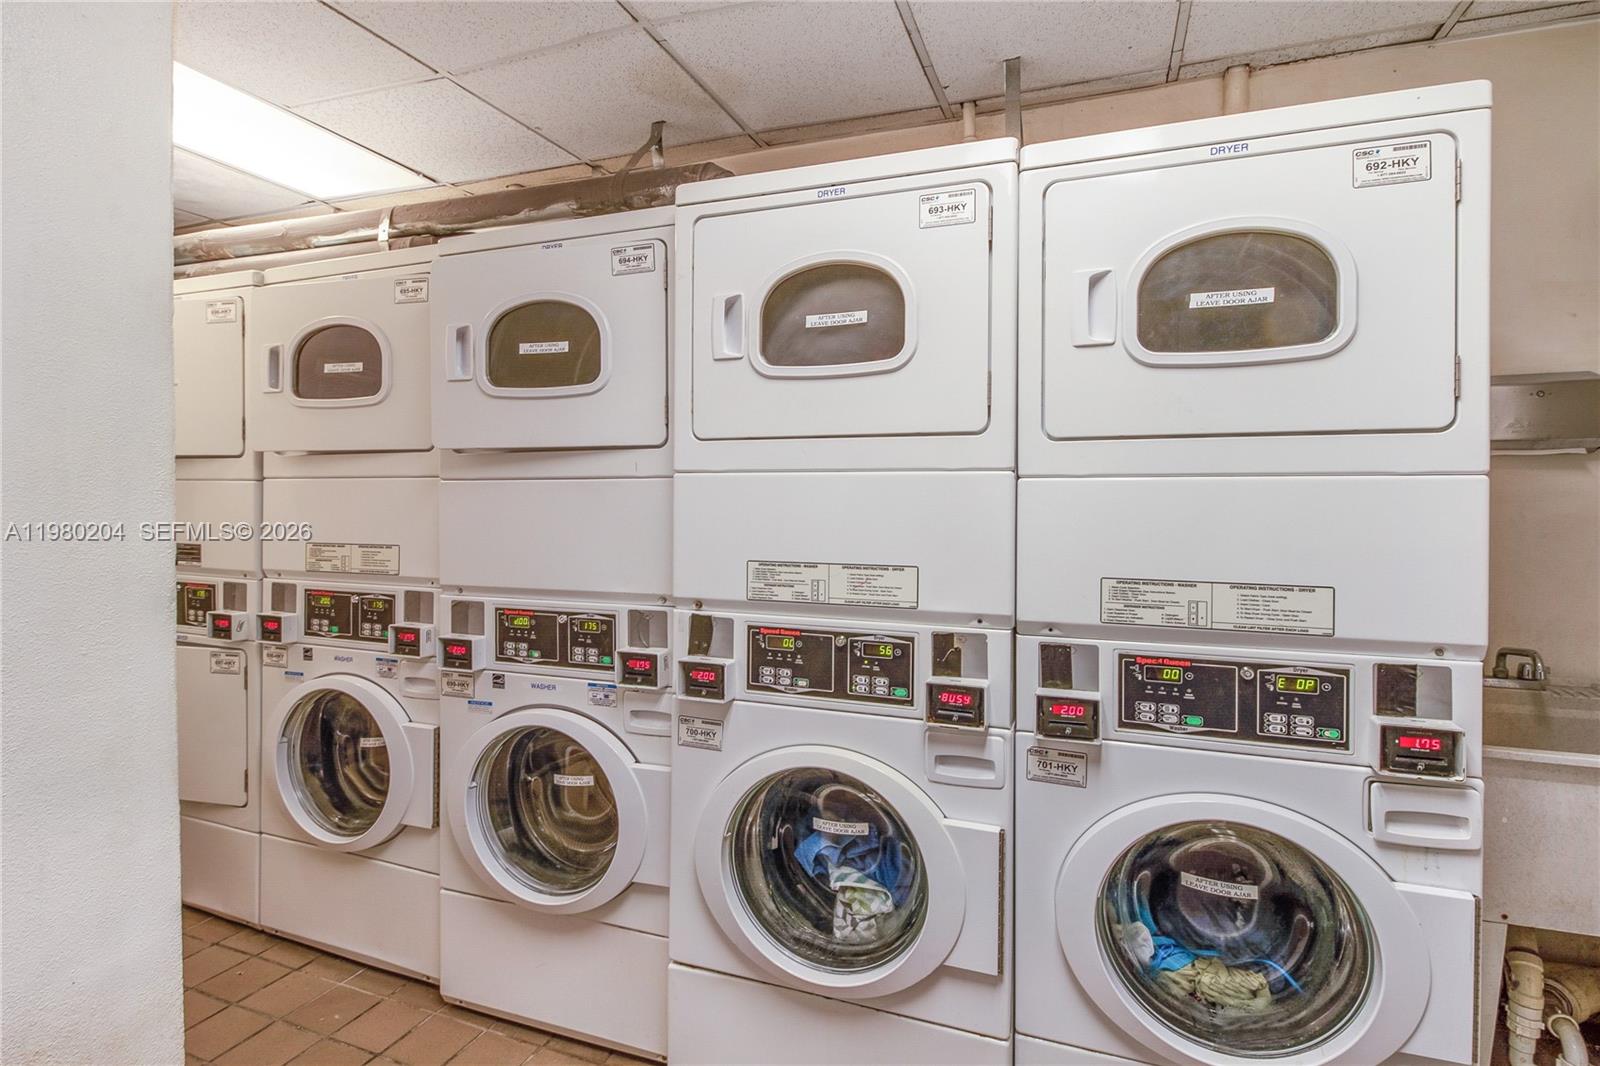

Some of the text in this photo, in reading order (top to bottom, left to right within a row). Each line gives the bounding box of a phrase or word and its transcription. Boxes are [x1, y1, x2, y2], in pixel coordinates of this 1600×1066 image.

[1210, 143, 1248, 155] DRYER
[1366, 157, 1420, 172] 692-HKY
[817, 187, 846, 198] DRYER
[928, 203, 967, 214] 693-HKY
[618, 255, 648, 264] 694-HKY
[880, 645, 892, 655] 56
[1164, 659, 1191, 667] Queen
[1163, 669, 1179, 679] 00
[1278, 678, 1285, 688] E
[942, 693, 970, 704] BUSY
[686, 728, 717, 738] 700-HKY
[1037, 760, 1078, 772] 701-HKY
[1186, 880, 1208, 890] LEAVE
[1196, 878, 1218, 886] AFTER
